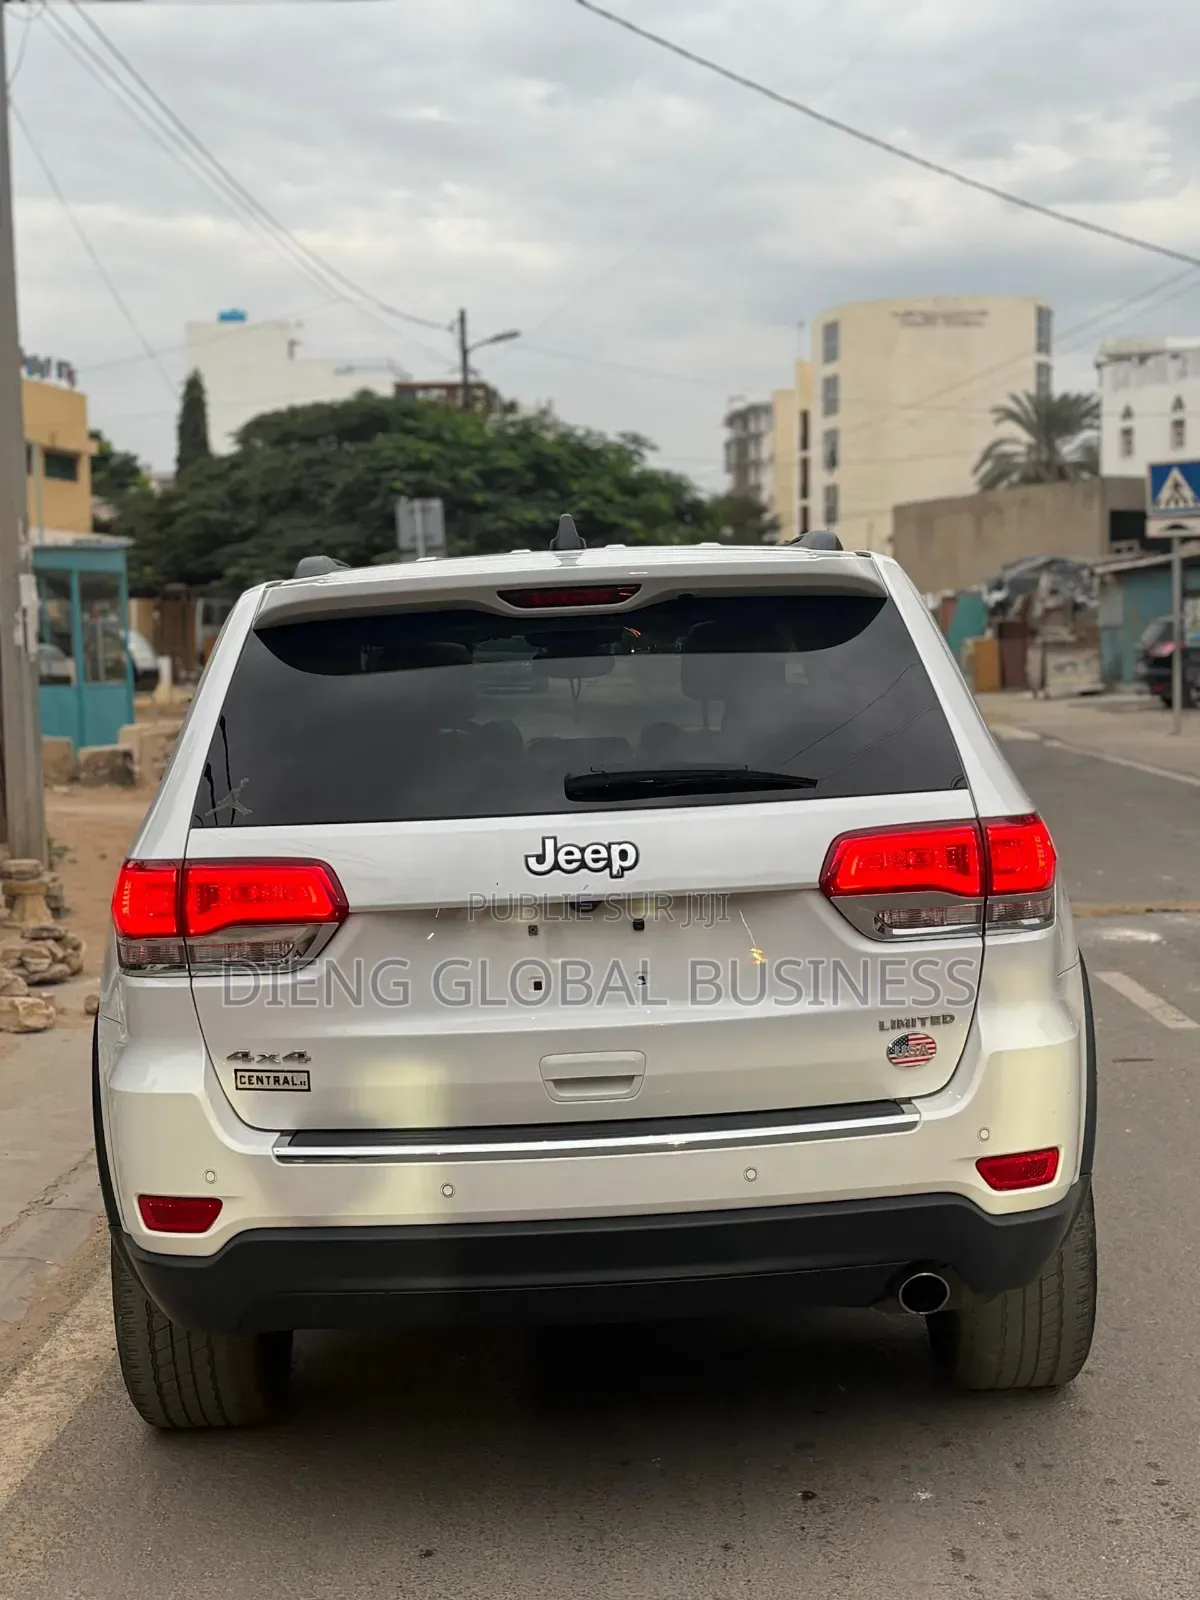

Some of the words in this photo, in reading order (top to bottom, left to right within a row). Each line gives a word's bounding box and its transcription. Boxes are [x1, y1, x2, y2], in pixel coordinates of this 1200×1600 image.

[524, 836, 640, 879] Jeep
[878, 1014, 956, 1032] LIMITED
[893, 1043, 930, 1059] USA
